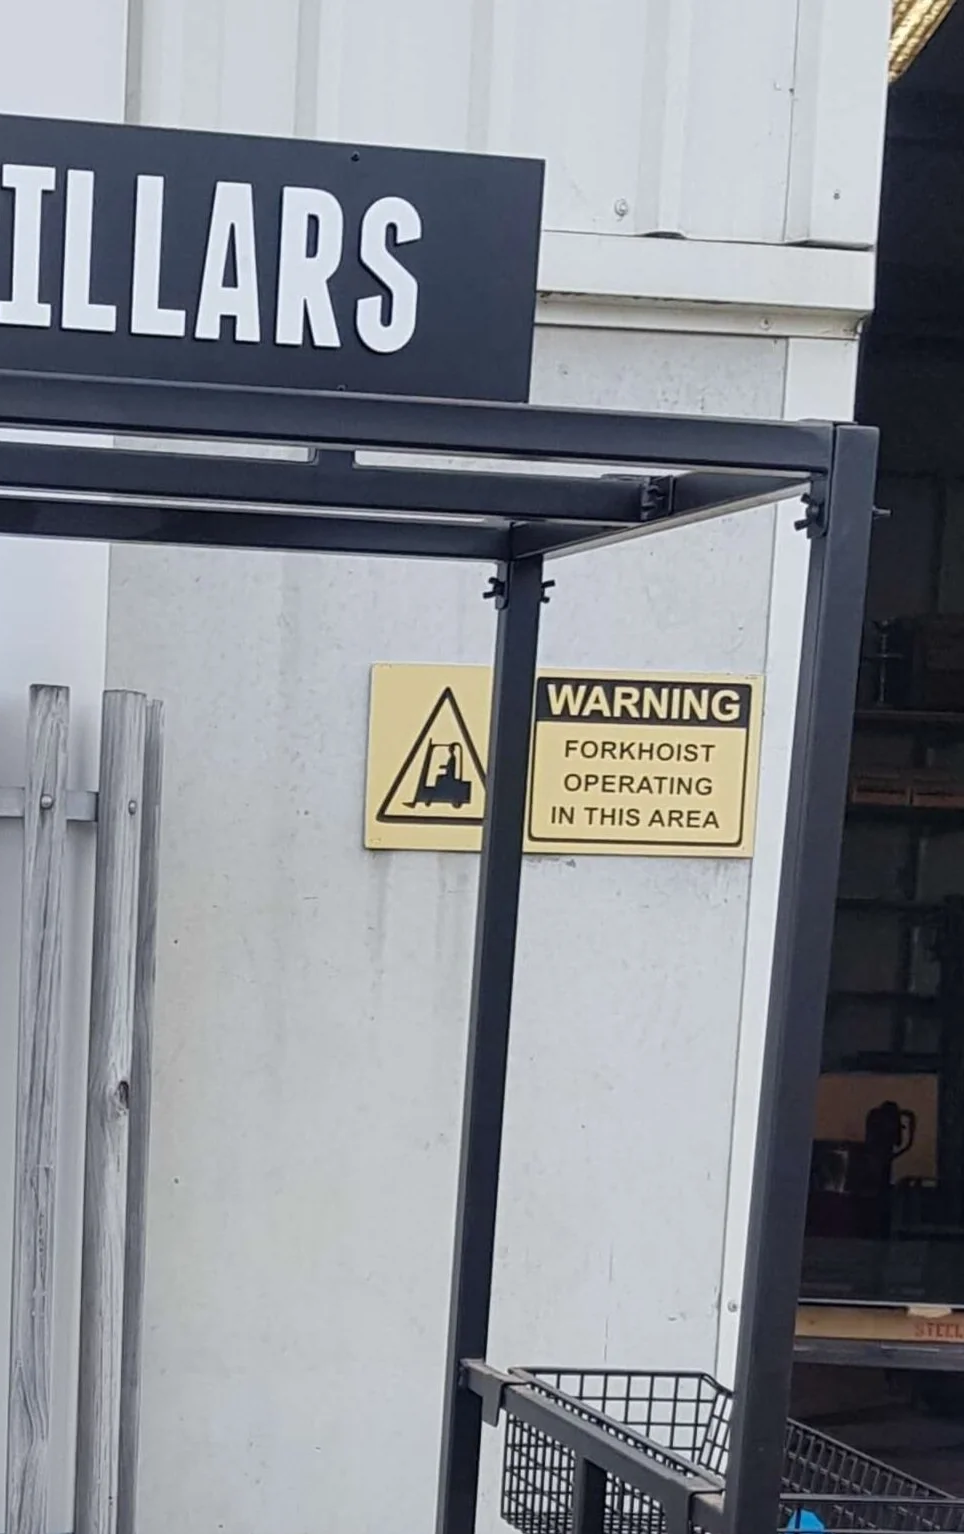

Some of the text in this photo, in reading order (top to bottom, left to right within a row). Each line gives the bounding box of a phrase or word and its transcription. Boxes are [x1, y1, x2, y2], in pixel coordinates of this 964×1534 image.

[547, 683, 741, 722] WARNING
[564, 739, 716, 763] FORKHOIST
[563, 773, 713, 796] OPERATING
[551, 806, 720, 829] IN THIS AREA
